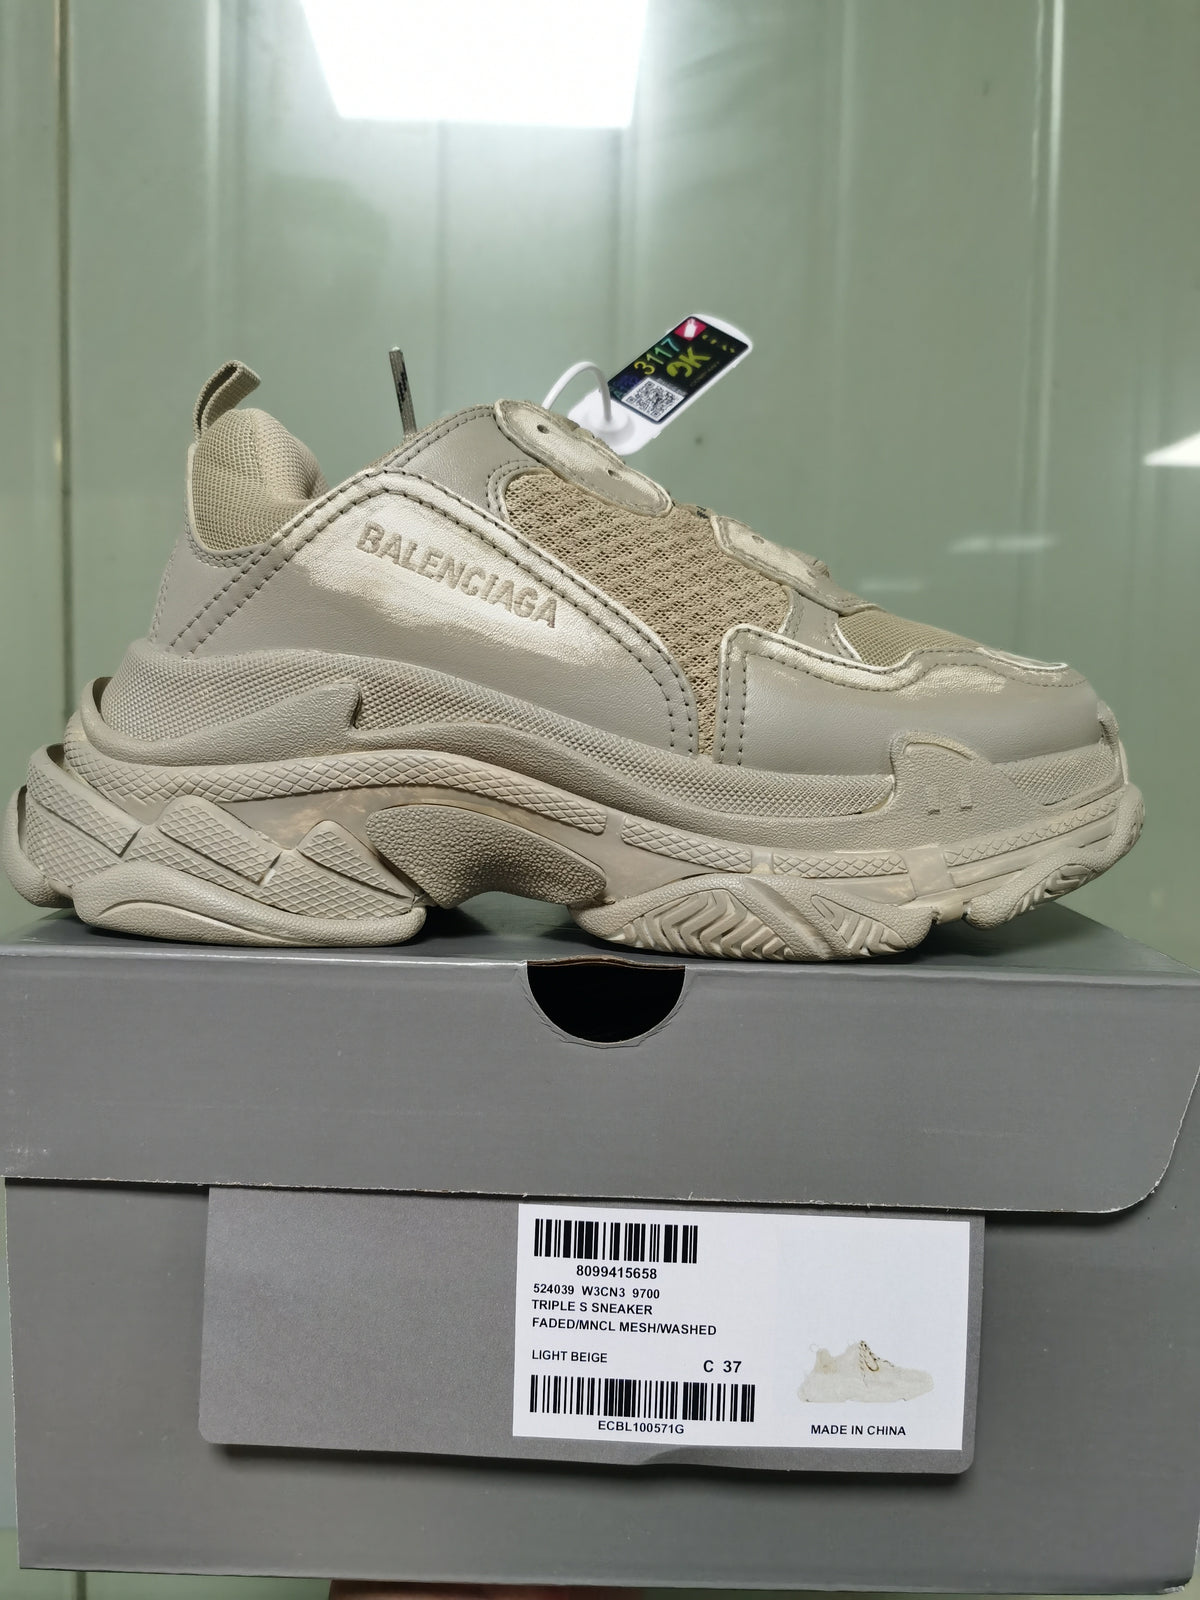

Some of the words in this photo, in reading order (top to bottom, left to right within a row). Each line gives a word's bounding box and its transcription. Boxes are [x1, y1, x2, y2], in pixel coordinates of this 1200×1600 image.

[633, 337, 681, 376] 3117
[355, 519, 558, 630] BALENCIAGA
[576, 1264, 658, 1280] 8099415658
[533, 1283, 575, 1295] 524039
[581, 1285, 626, 1298] W3CN3
[632, 1287, 660, 1300] 9700
[531, 1299, 576, 1312] TRIPLE
[579, 1302, 588, 1314] S
[591, 1302, 653, 1316] SNEAKER
[532, 1318, 616, 1332] FADED/MNCL
[619, 1322, 717, 1336] MESH/WASHED
[531, 1349, 568, 1361] LIGHT
[570, 1351, 608, 1364] BEIGE
[703, 1359, 714, 1374] C
[722, 1360, 742, 1374] 37
[597, 1420, 685, 1434] ECBL100571G
[810, 1424, 848, 1435] MADE
[852, 1425, 864, 1436] IN
[865, 1425, 907, 1437] CHINA
